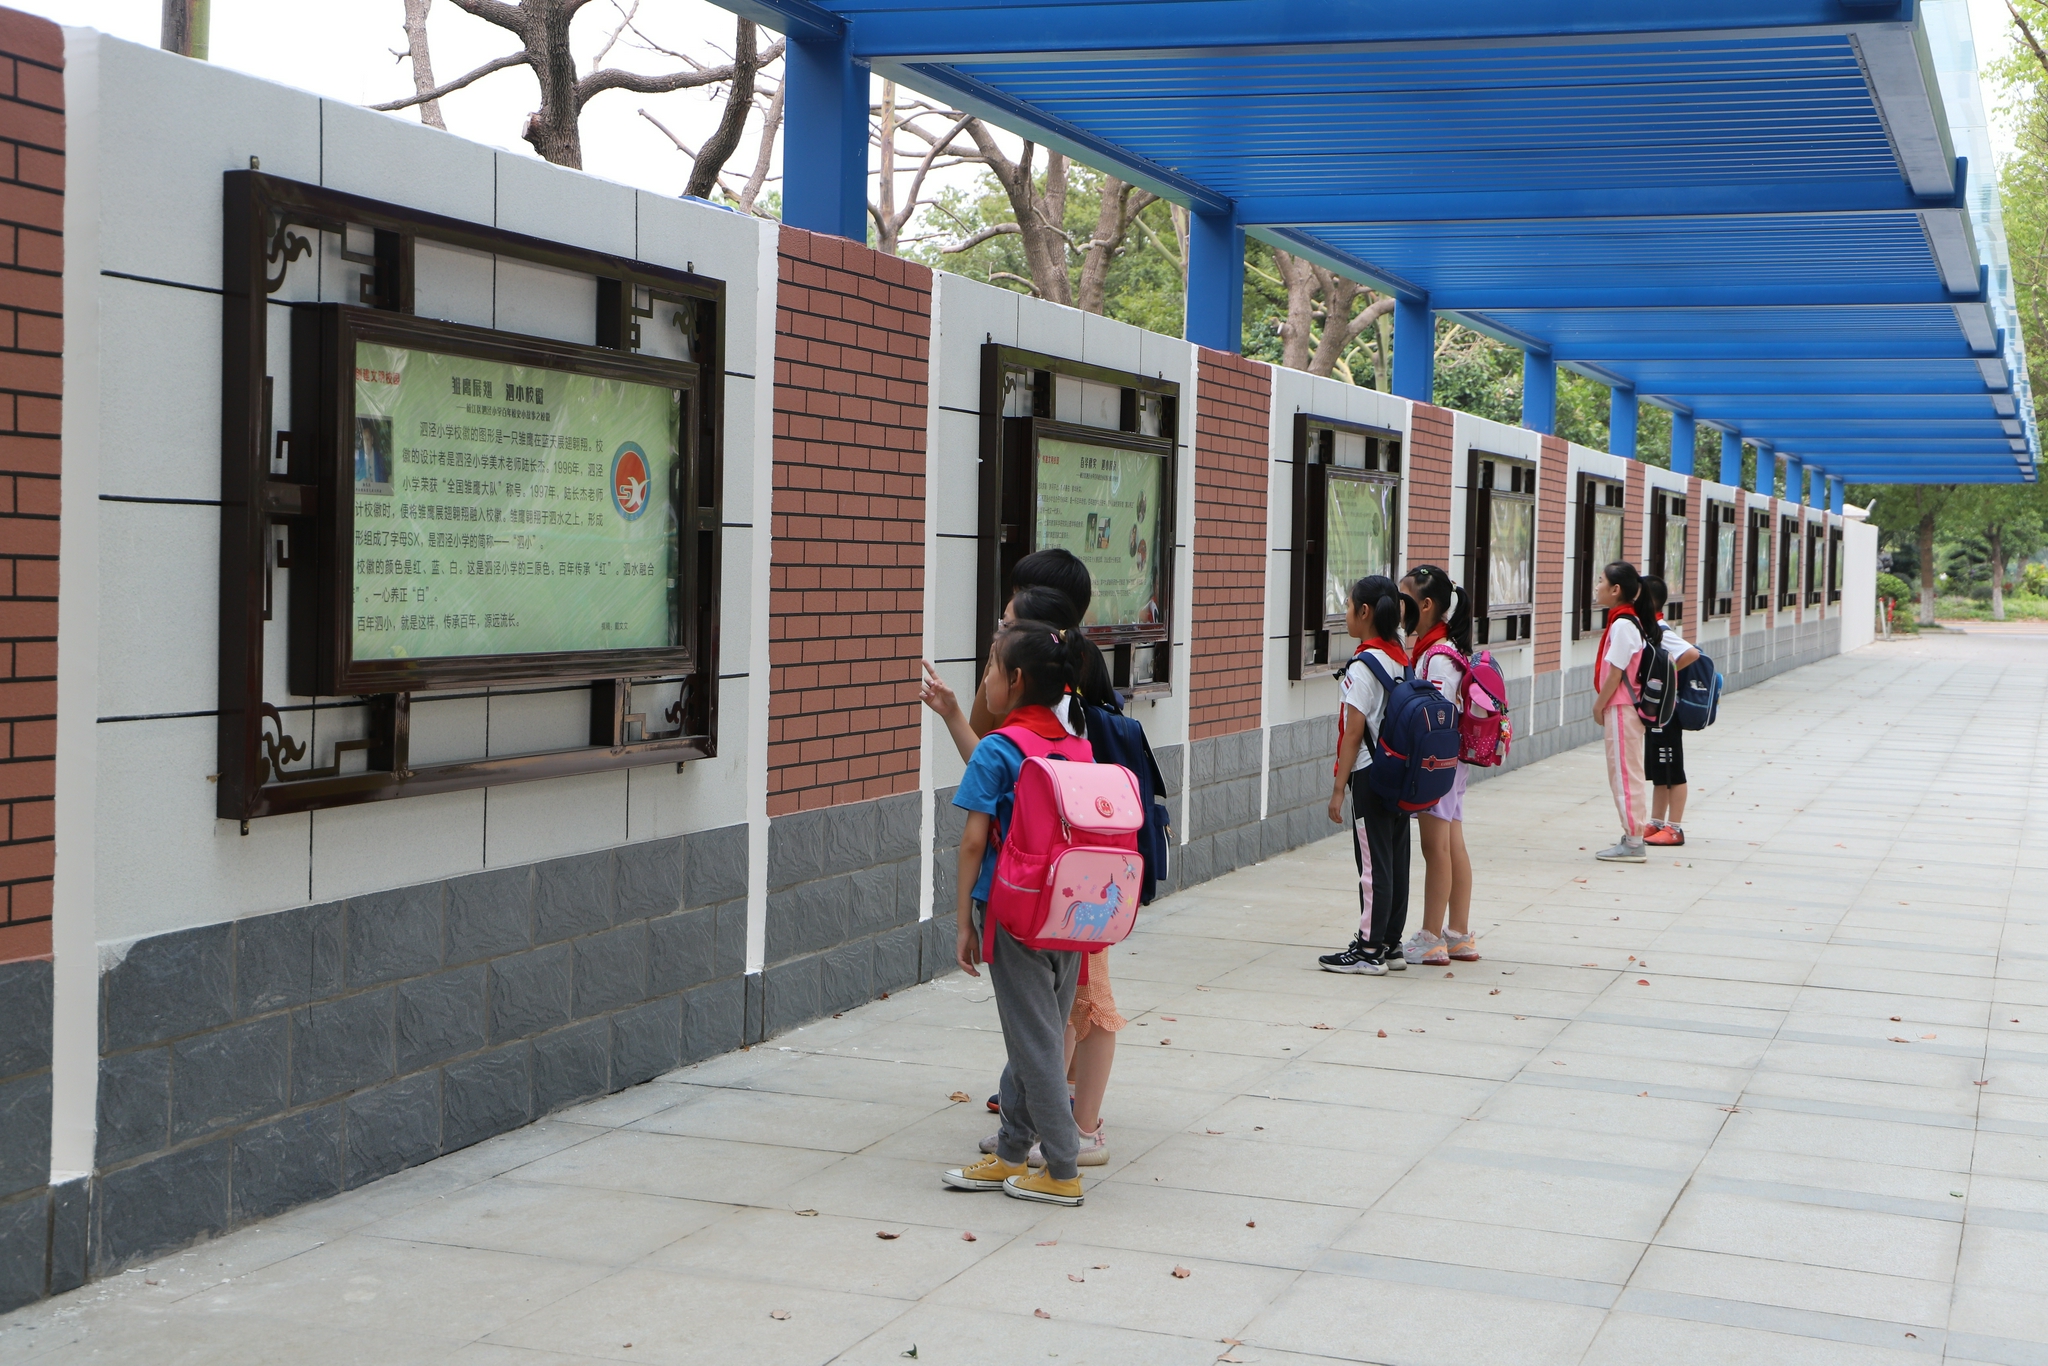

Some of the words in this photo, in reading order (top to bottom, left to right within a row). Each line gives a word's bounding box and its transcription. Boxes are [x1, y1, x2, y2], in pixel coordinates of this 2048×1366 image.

[452, 376, 492, 399] 雏鹰展翅
[505, 383, 544, 405] 泗小校徽
